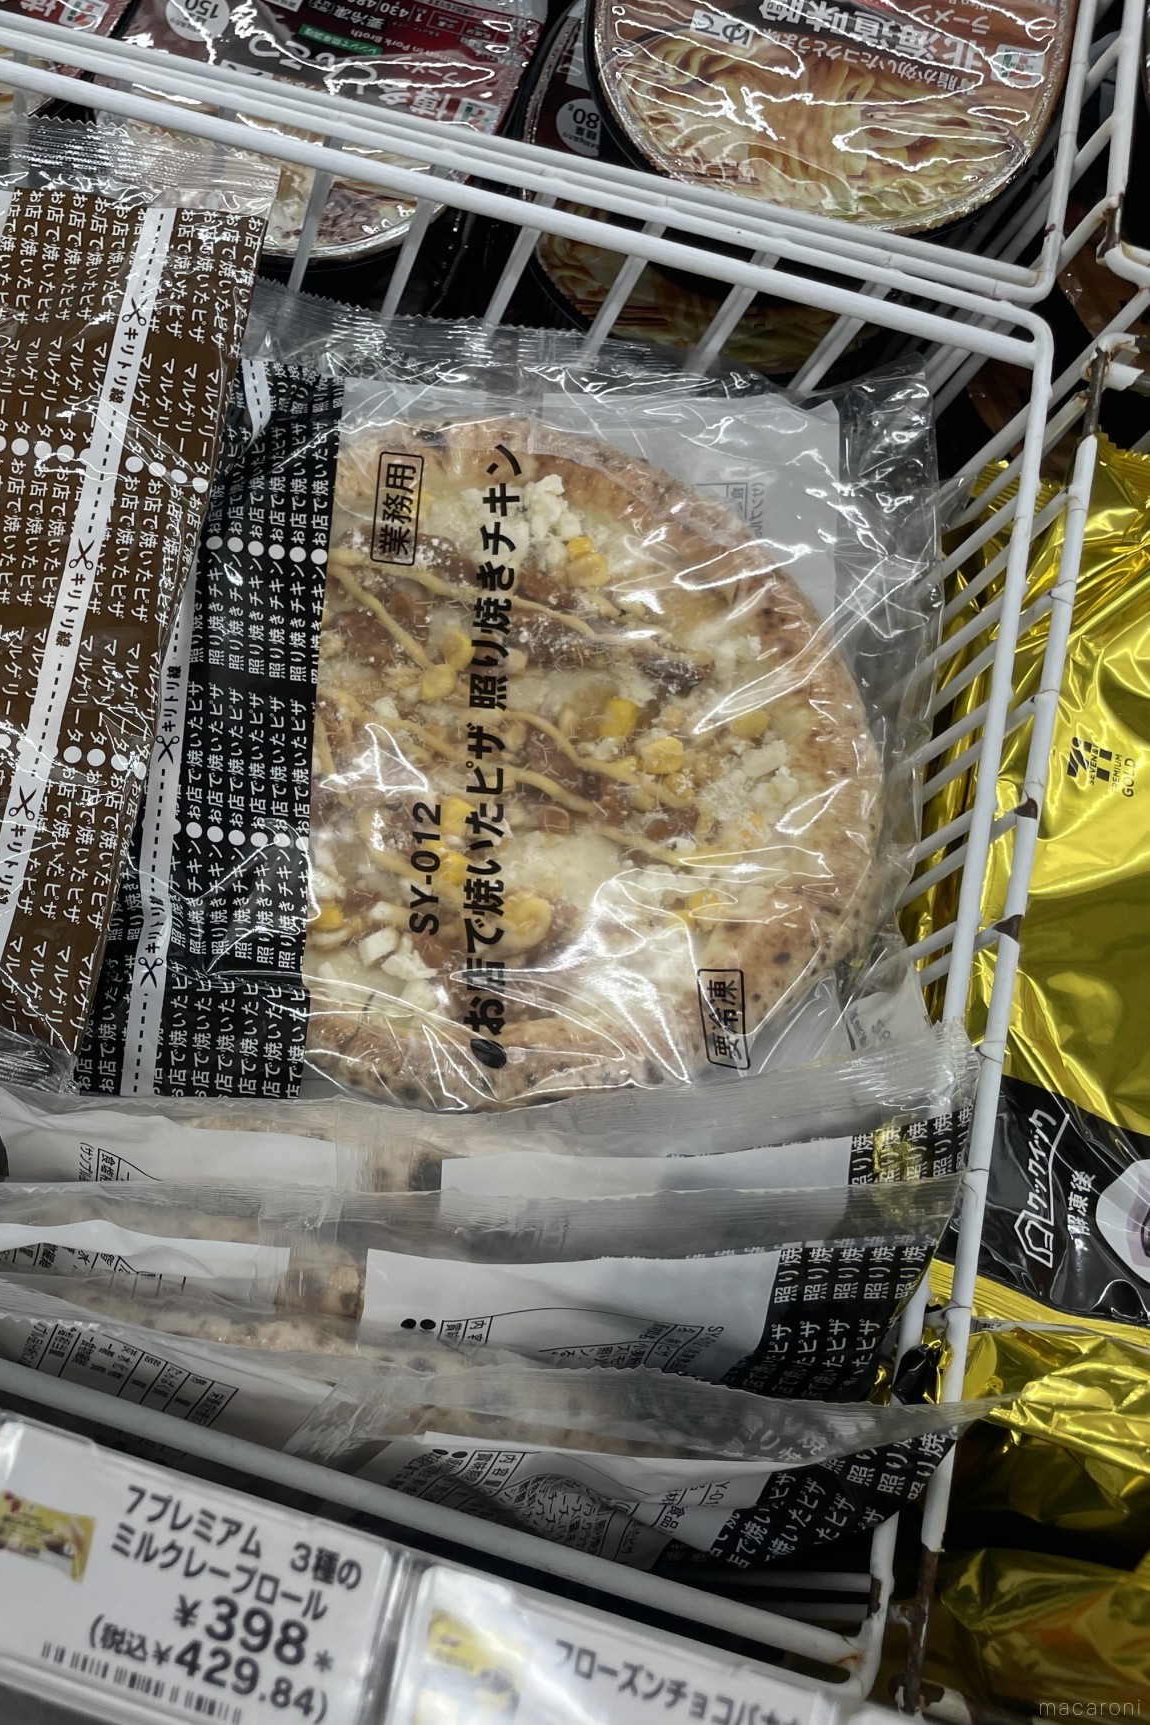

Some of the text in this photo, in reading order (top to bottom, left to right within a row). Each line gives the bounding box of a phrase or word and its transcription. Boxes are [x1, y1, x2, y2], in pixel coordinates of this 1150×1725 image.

[350, 28, 382, 46] Broth
[758, 0, 987, 70] 北海道味噌
[921, 3, 991, 35] ラーメン
[12, 191, 44, 324] お店で焼いたピザ
[77, 197, 111, 321] お店で焼いたピザ
[15, 192, 65, 433] お店で焼いたピザ マルゲリータ
[37, 193, 88, 437] お店で焼いたピザ マルゲリータ
[107, 327, 138, 405] キリトリ線
[378, 461, 418, 556] 業務用
[54, 572, 87, 647] キリトリ線
[162, 665, 182, 732] キリトリ線
[463, 445, 526, 1037] お店で焼いたピザ 照り焼きチキン
[1122, 758, 1136, 798] GOLD
[408, 802, 442, 936] SY-012
[707, 977, 740, 1062] 要冷凍
[111, 1521, 329, 1623] ミルクレープロール
[124, 1483, 363, 1591] 7プレミアム 3種の
[88, 1612, 329, 1725] (税込¥429.84)
